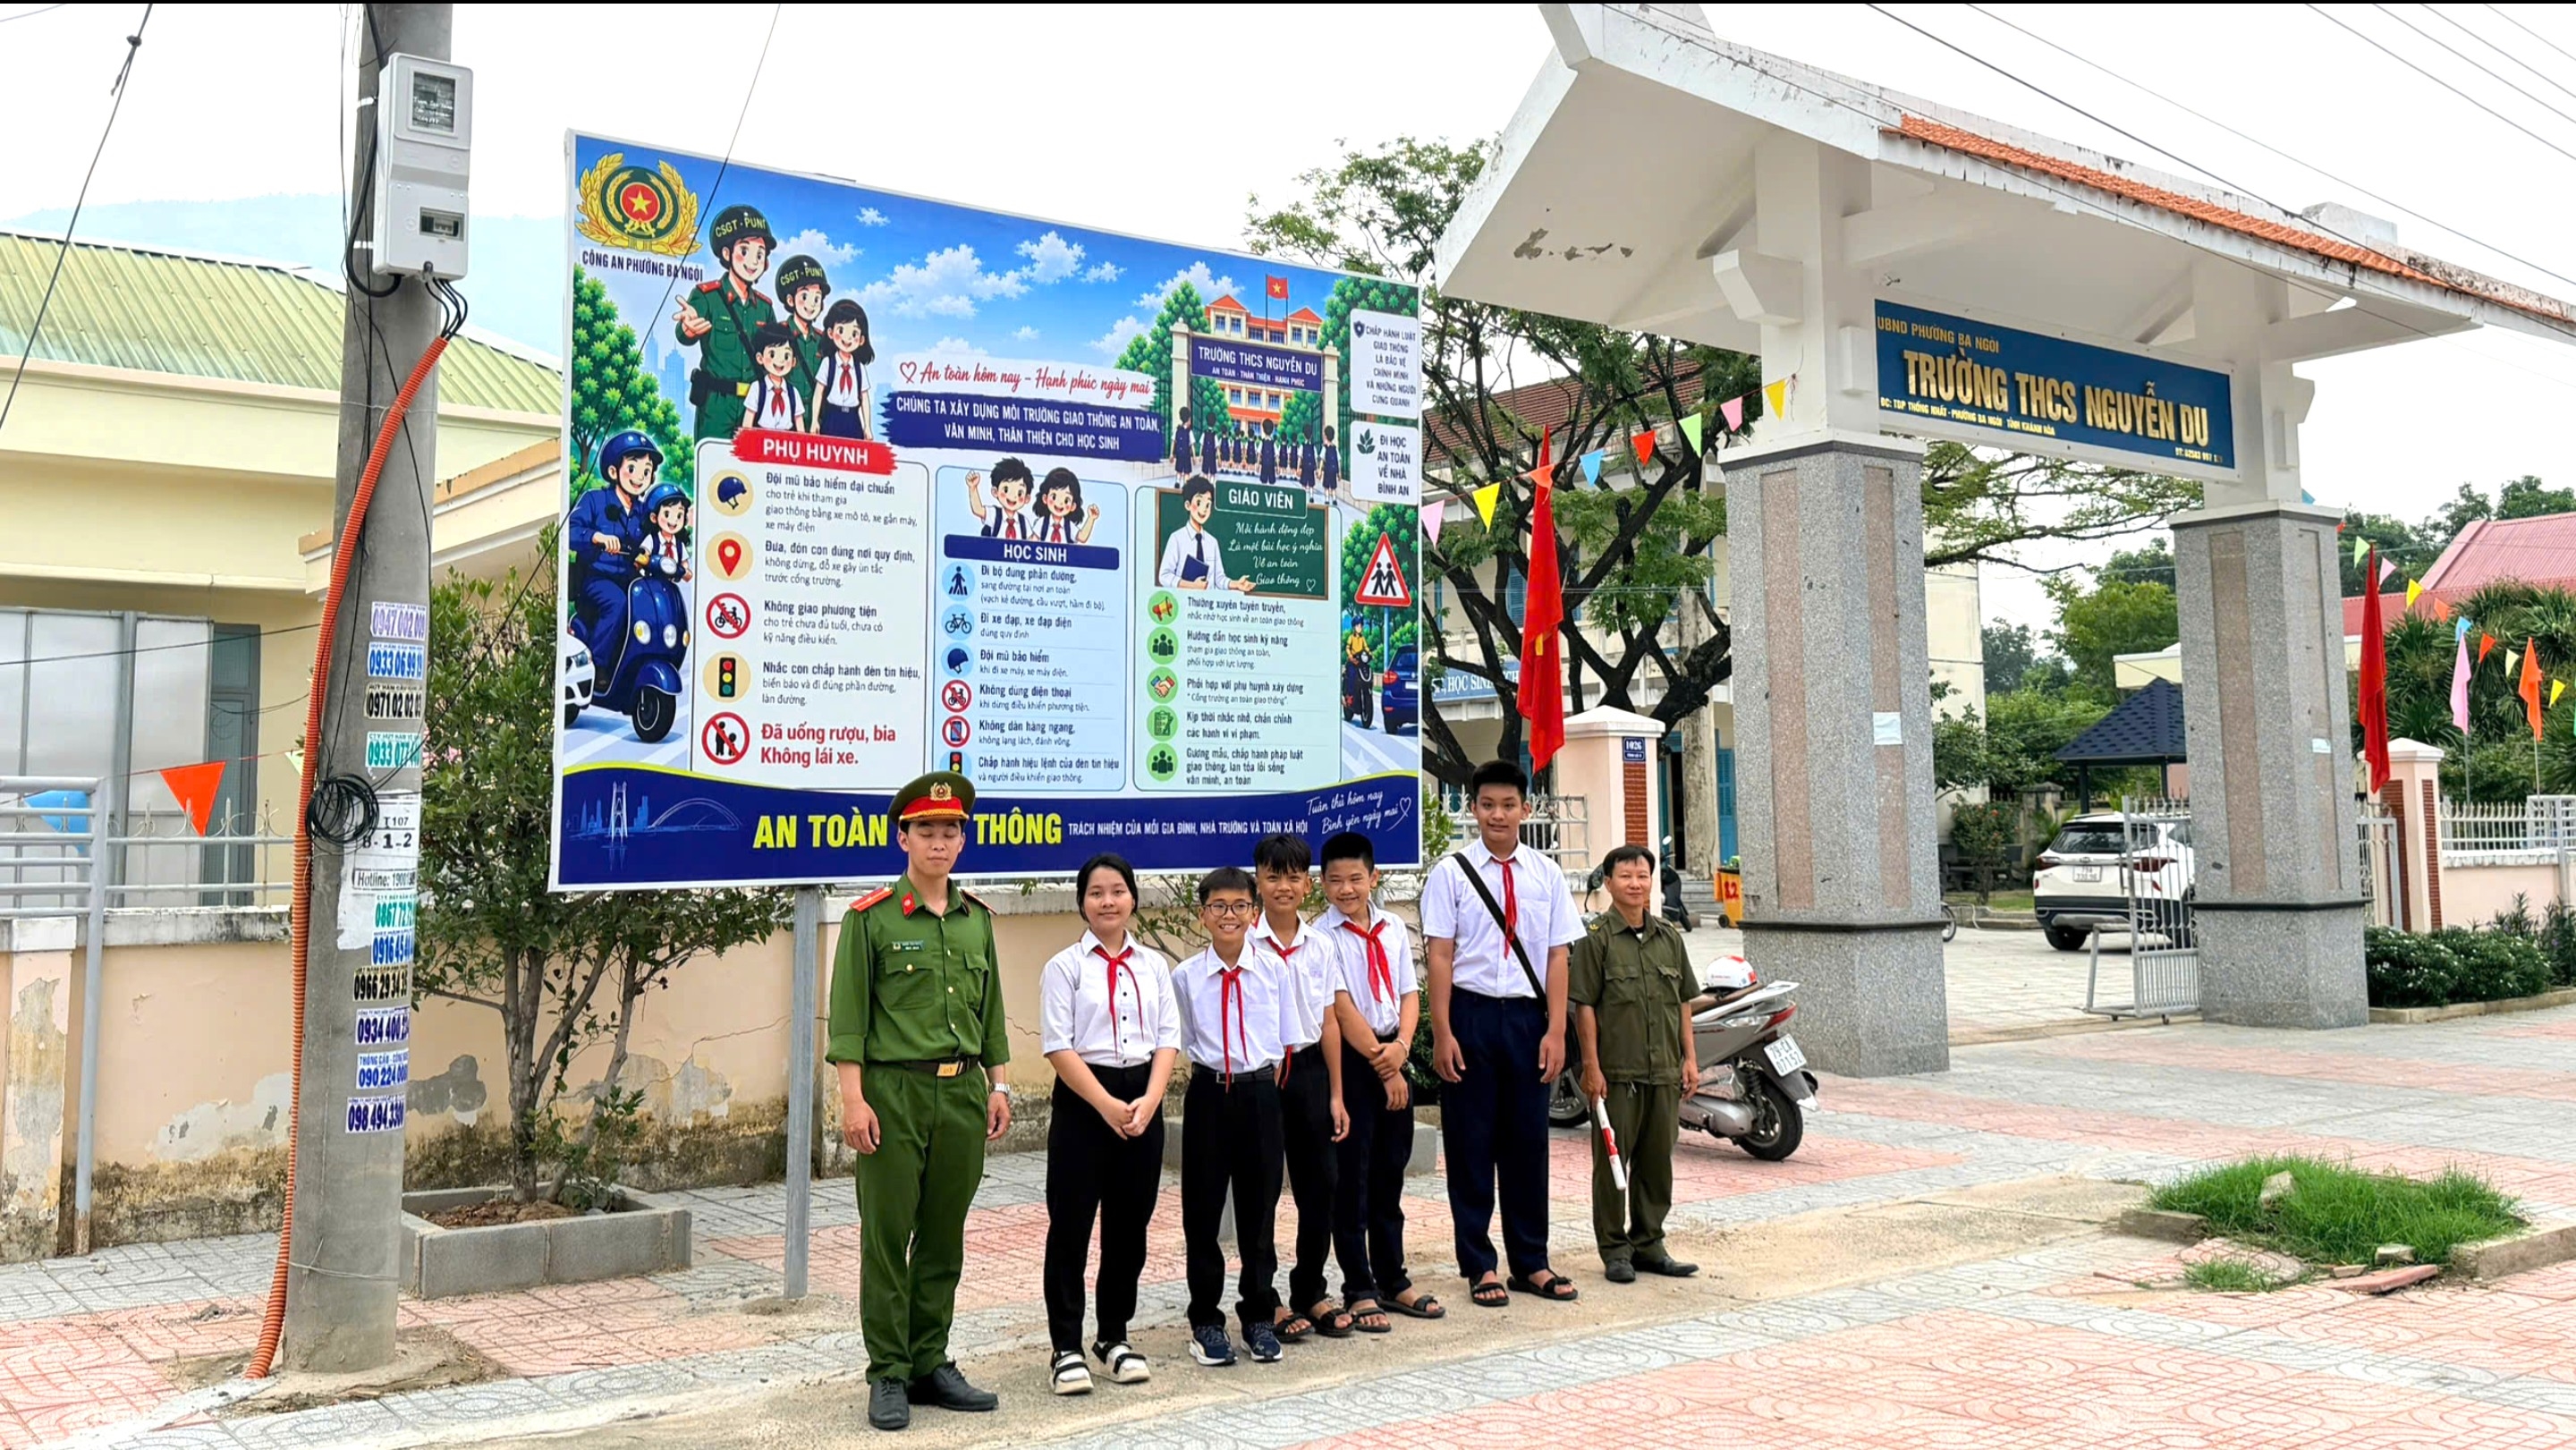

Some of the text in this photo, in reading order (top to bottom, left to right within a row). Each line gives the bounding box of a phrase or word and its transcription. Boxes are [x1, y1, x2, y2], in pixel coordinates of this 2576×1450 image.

[716, 218, 738, 237] CSGT
[582, 249, 608, 267] CÔNG
[611, 255, 624, 270] AN
[626, 257, 665, 276] PHƯỜNG
[681, 265, 703, 282] NGÒI
[780, 269, 800, 286] CSGT
[1877, 316, 1999, 353] UBND PHƯỜNG BA NGÒI
[1198, 345, 1237, 363] TRƯỜNG
[1239, 352, 1263, 369] THCS
[1305, 362, 1318, 376] DU
[919, 360, 1151, 400] An toàn hôm nay Hạnh phúc ngày mai
[1212, 366, 1220, 375] AN
[1221, 367, 1236, 377] TOÀN
[1903, 347, 2209, 447] TRƯỜNG THCS NGUYỄN DU
[896, 394, 1160, 434] CHÚNG TA XÂY DỰNG MÔI TRƯỜNG GIAO THÔNG AN TOÀN,
[1978, 413, 1987, 424] BA
[944, 421, 1120, 452] VĂN MINH, THÂN THIỆN CHO HỌC SINH
[1379, 434, 1407, 449] ĐI HỌC
[763, 438, 869, 466] PHỤ HUYNH
[1377, 449, 1411, 464] AN TOÀN
[1390, 465, 1407, 480] NHÀ
[766, 471, 895, 495] Đội mũ bảo hiểm đại chuẩn
[1397, 484, 1410, 496] AN
[766, 489, 782, 499] cho
[797, 491, 810, 502] khi
[811, 492, 834, 504] tham
[835, 495, 847, 506] gia
[1228, 487, 1293, 510] GIÁO VIÊN
[790, 541, 808, 555] đón
[810, 545, 828, 555] con
[831, 544, 854, 559] đúng
[857, 547, 872, 559] nơi
[874, 549, 891, 562] quy
[894, 549, 916, 564] định,
[1004, 543, 1067, 564] HỌC SINH
[764, 599, 877, 619] Không giao phương tiện
[980, 612, 990, 623] Đi
[992, 615, 1002, 623] xe
[1024, 616, 1035, 625] xe
[762, 661, 788, 674] Nhắc
[791, 664, 806, 675] con
[863, 664, 881, 677] đèn
[899, 666, 921, 681] hiệu,
[1447, 674, 1469, 695] HỌC
[760, 720, 896, 746] Đã uống rượu, bia
[760, 746, 859, 768] Không lái xe.
[1346, 792, 1366, 807] hôm
[1367, 790, 1384, 809] nay
[1384, 805, 1399, 818] mai
[752, 805, 1062, 851] AN TOÀN THÔNG
[1068, 819, 1095, 836] TRÁCH
[1097, 818, 1123, 836] NHIỆM
[1124, 818, 1142, 836] CỦA
[1161, 821, 1175, 835] GIA
[1176, 818, 1199, 837] ĐÌNH,
[1199, 818, 1216, 835] NHÀ
[1218, 817, 1249, 835] TRƯỜNG
[1250, 817, 1260, 834] VÀ
[1262, 817, 1282, 834] TOÀN
[1283, 817, 1294, 834] XÃ
[1295, 819, 1308, 835] HỘI
[358, 871, 390, 887] Hotline:
